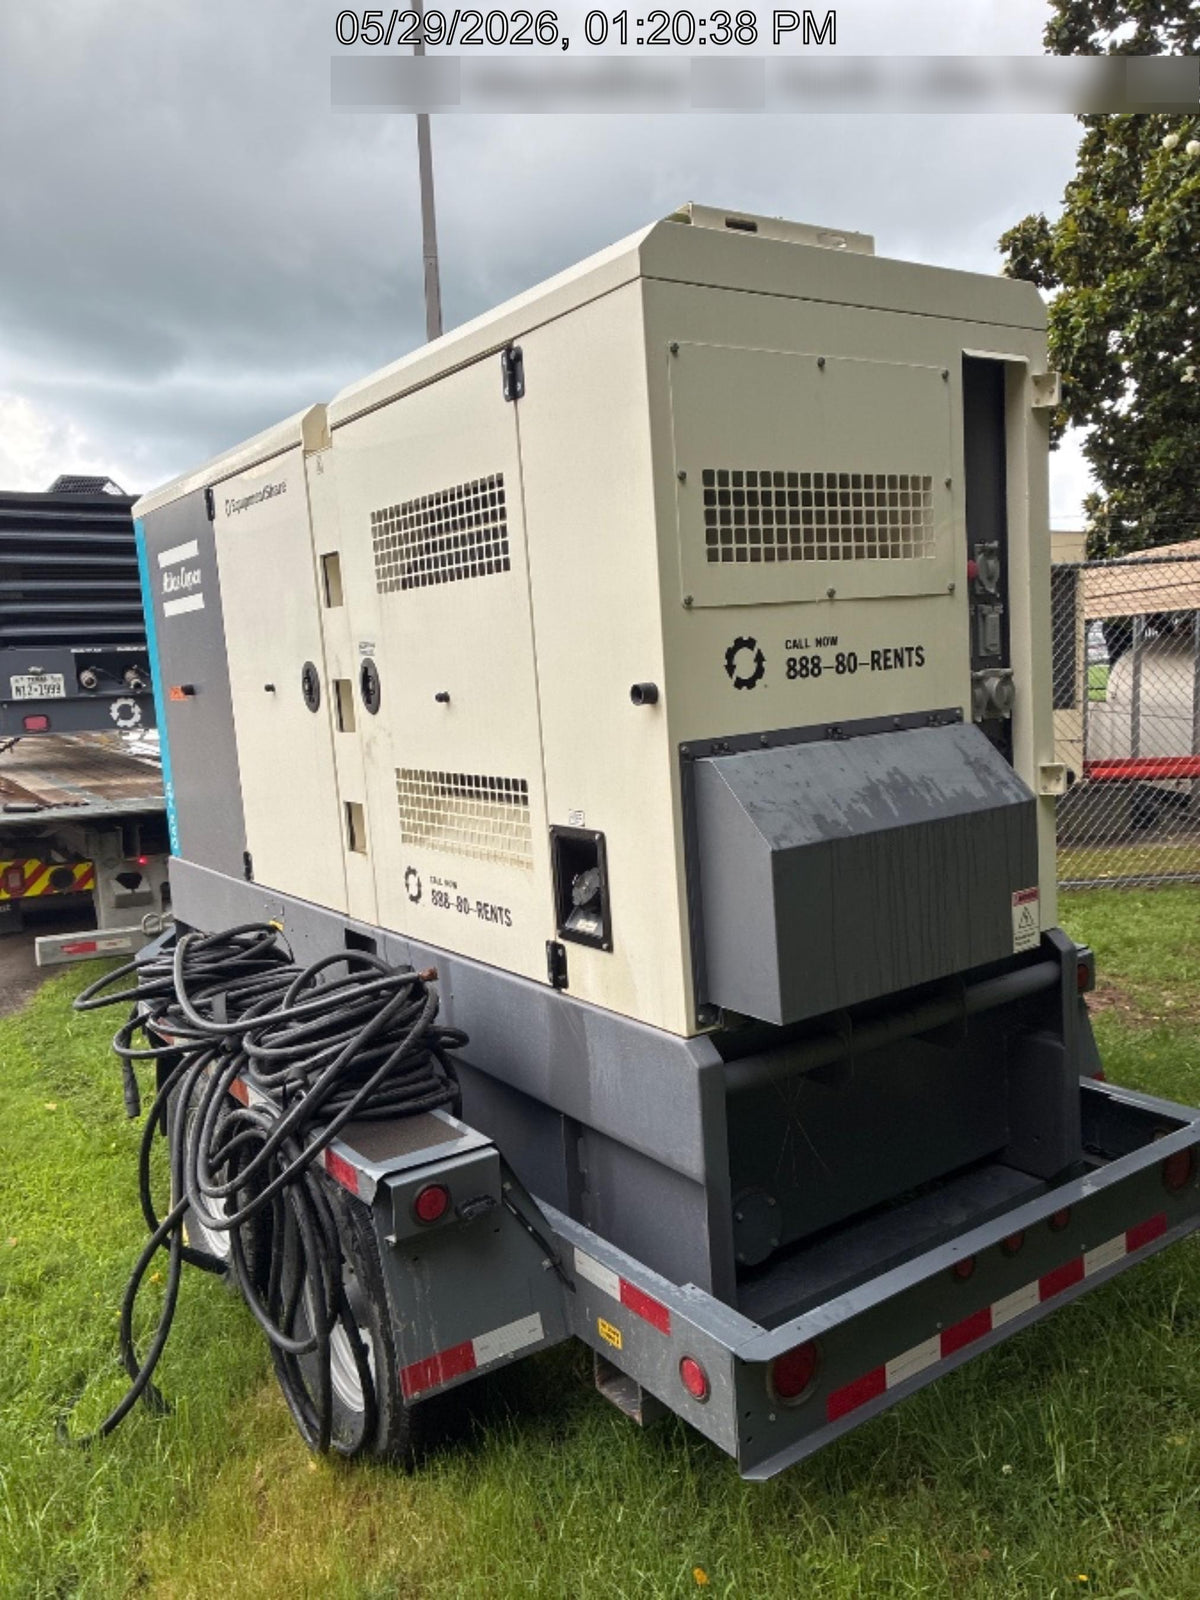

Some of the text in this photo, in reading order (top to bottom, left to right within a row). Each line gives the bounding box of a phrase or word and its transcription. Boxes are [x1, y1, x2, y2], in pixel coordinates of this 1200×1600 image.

[785, 636, 838, 650] CALL NOW
[785, 645, 926, 680] 888-80-RENTS
